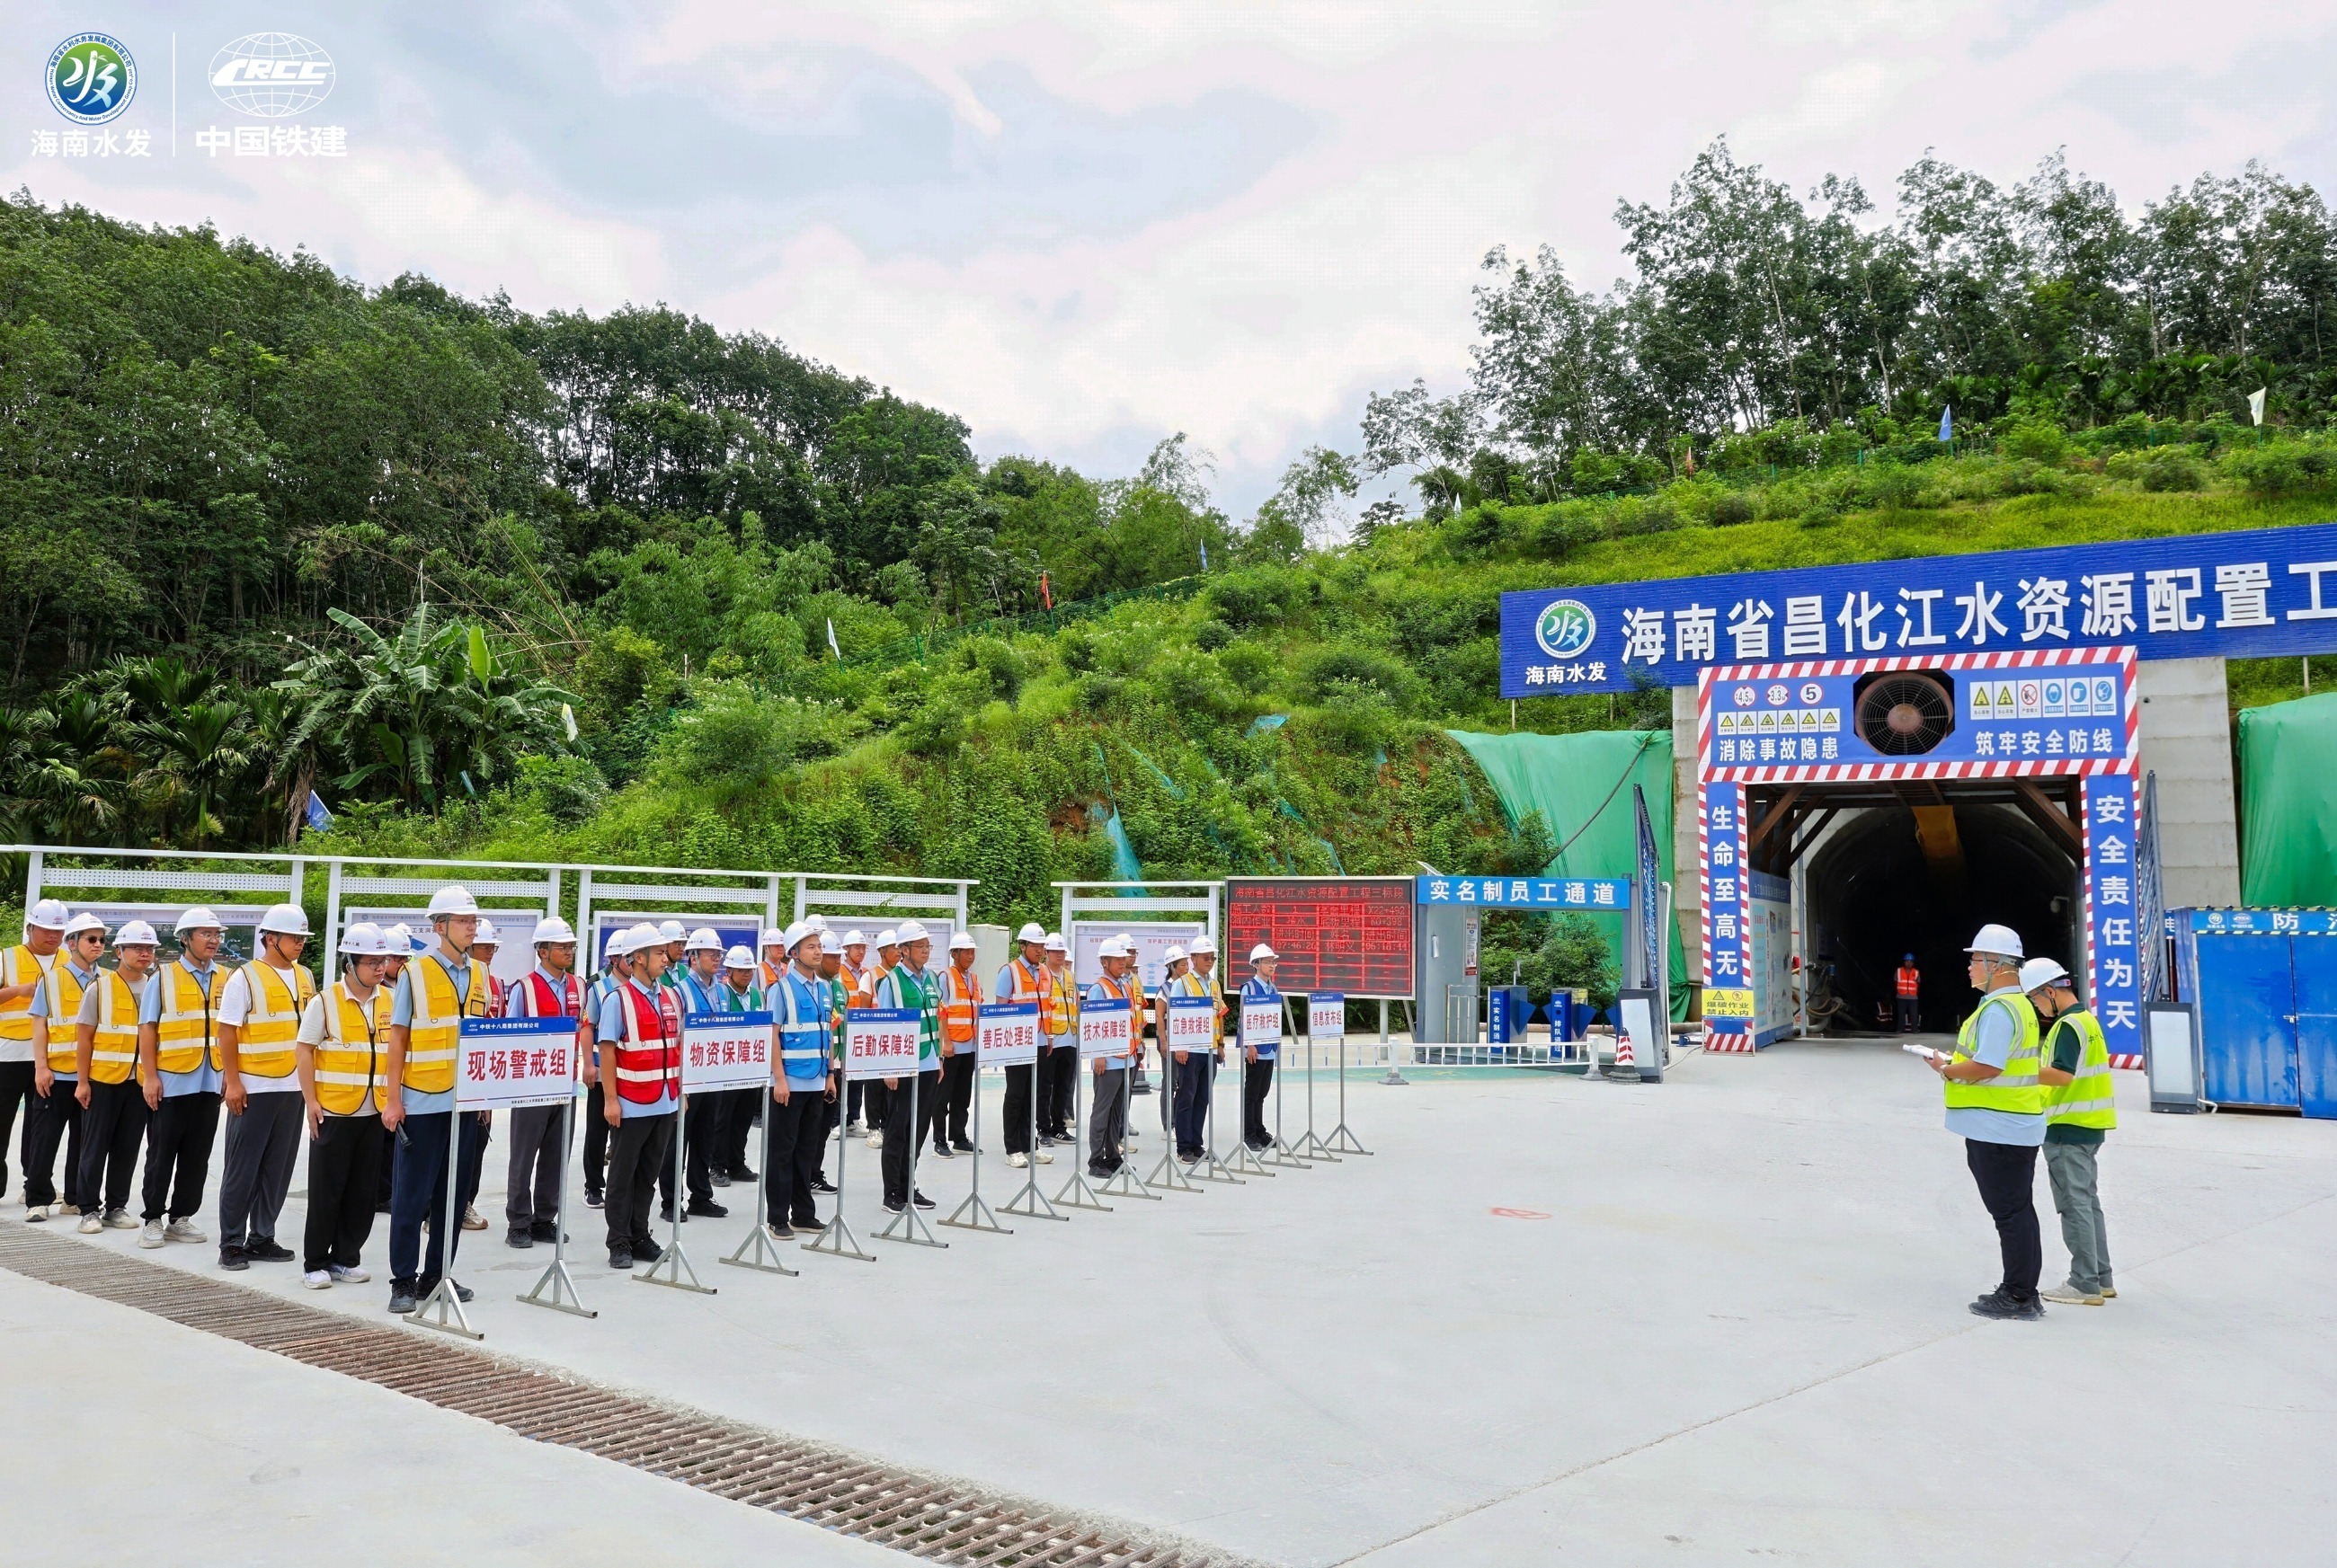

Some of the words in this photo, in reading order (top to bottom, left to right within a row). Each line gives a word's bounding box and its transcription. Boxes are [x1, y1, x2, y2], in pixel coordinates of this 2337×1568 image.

[1621, 560, 2337, 666] 海南省昌化江水资源配置工
[1525, 661, 1607, 686] 海南水发
[1806, 687, 1817, 701] 5
[1719, 736, 1840, 762] 消除事故隐患
[1976, 729, 2113, 756] 筑牢安全防线
[1235, 887, 1404, 899] 海南省昌化江水资源配置工程三标段
[1430, 881, 1615, 905] 实名制员工通道
[1711, 805, 1737, 976] 生命至高无
[2095, 795, 2136, 1030] 安全责任为天
[1241, 929, 1260, 940] 姓名
[1275, 928, 1316, 940] 进出时间
[1330, 929, 1350, 940] 姓名
[1365, 929, 1408, 942] 进出时间
[1706, 1001, 1749, 1009] 爆破作业
[1173, 1016, 1210, 1035] 应急救援组
[1246, 1012, 1279, 1031] 医疗救护组
[1312, 1010, 1342, 1026] 信息发布组
[982, 1025, 1034, 1050] 善后处理组
[1083, 1020, 1126, 1042] 技术保障组
[689, 1039, 765, 1067] 物资保障组
[851, 1033, 914, 1058] 后勤保障组
[467, 1049, 566, 1082] 现场警戒组
